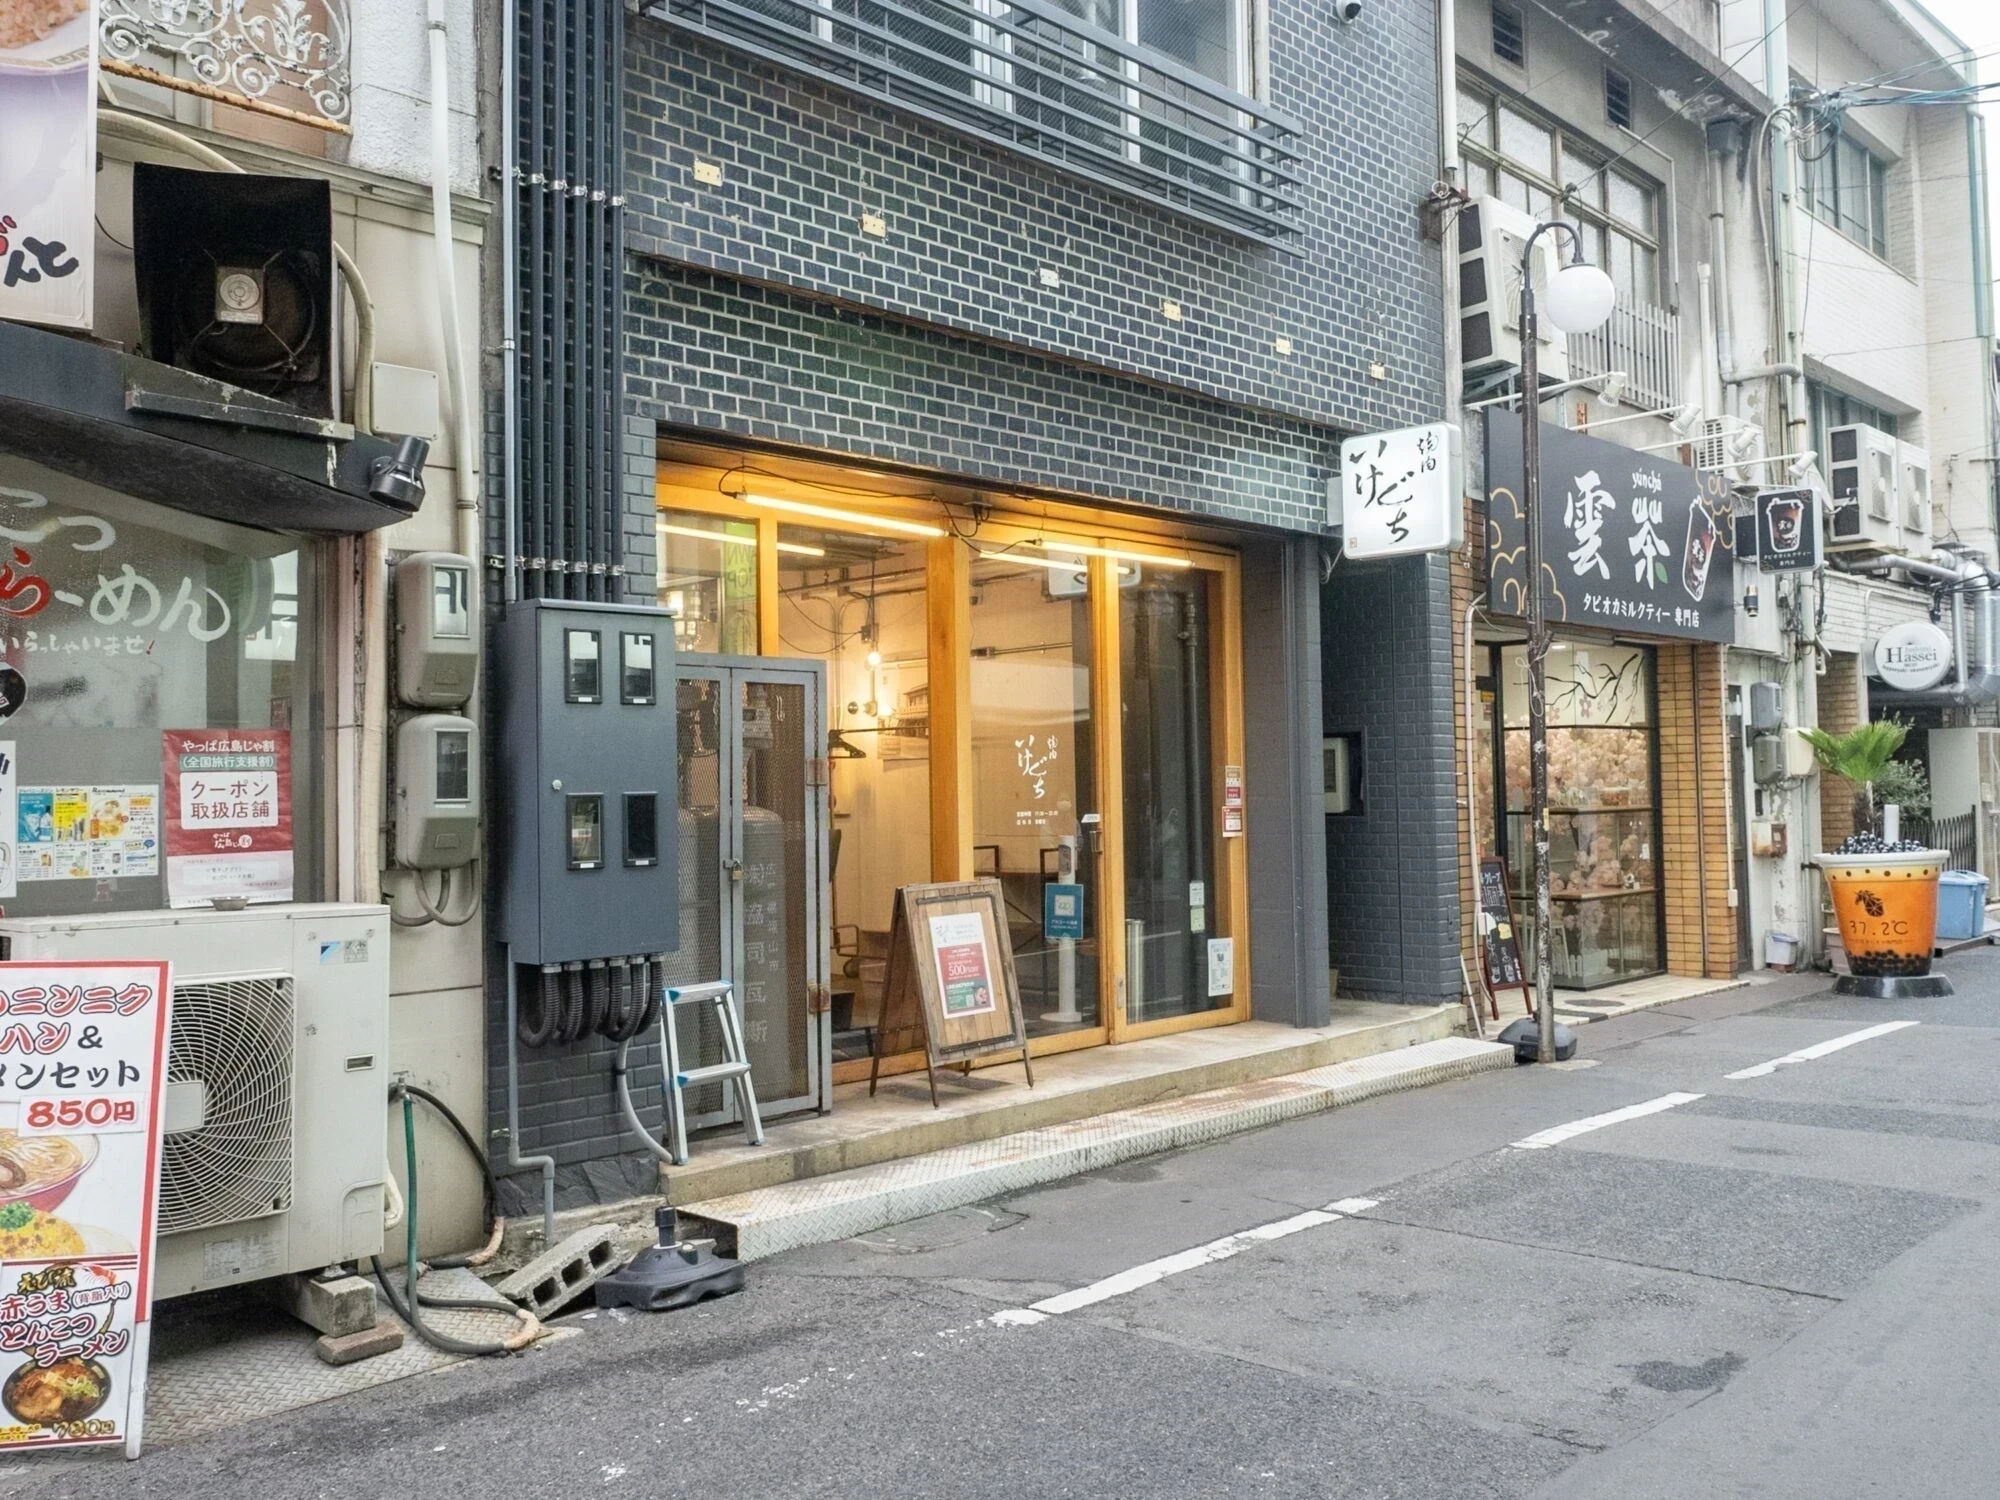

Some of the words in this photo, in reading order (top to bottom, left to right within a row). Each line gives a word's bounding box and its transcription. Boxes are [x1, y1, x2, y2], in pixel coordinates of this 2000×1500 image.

[1583, 592, 1671, 623] タピオカミルクティー
[1674, 606, 1700, 628] 専門店
[190, 779, 270, 800] クーポン
[190, 800, 271, 820] 取扱店舗
[0, 982, 152, 1018] ニンニク
[77, 1025, 103, 1049] &
[27, 1098, 136, 1128] 850円
[0, 1313, 95, 1350] とんこつ
[35, 1329, 128, 1368] ラーメン
